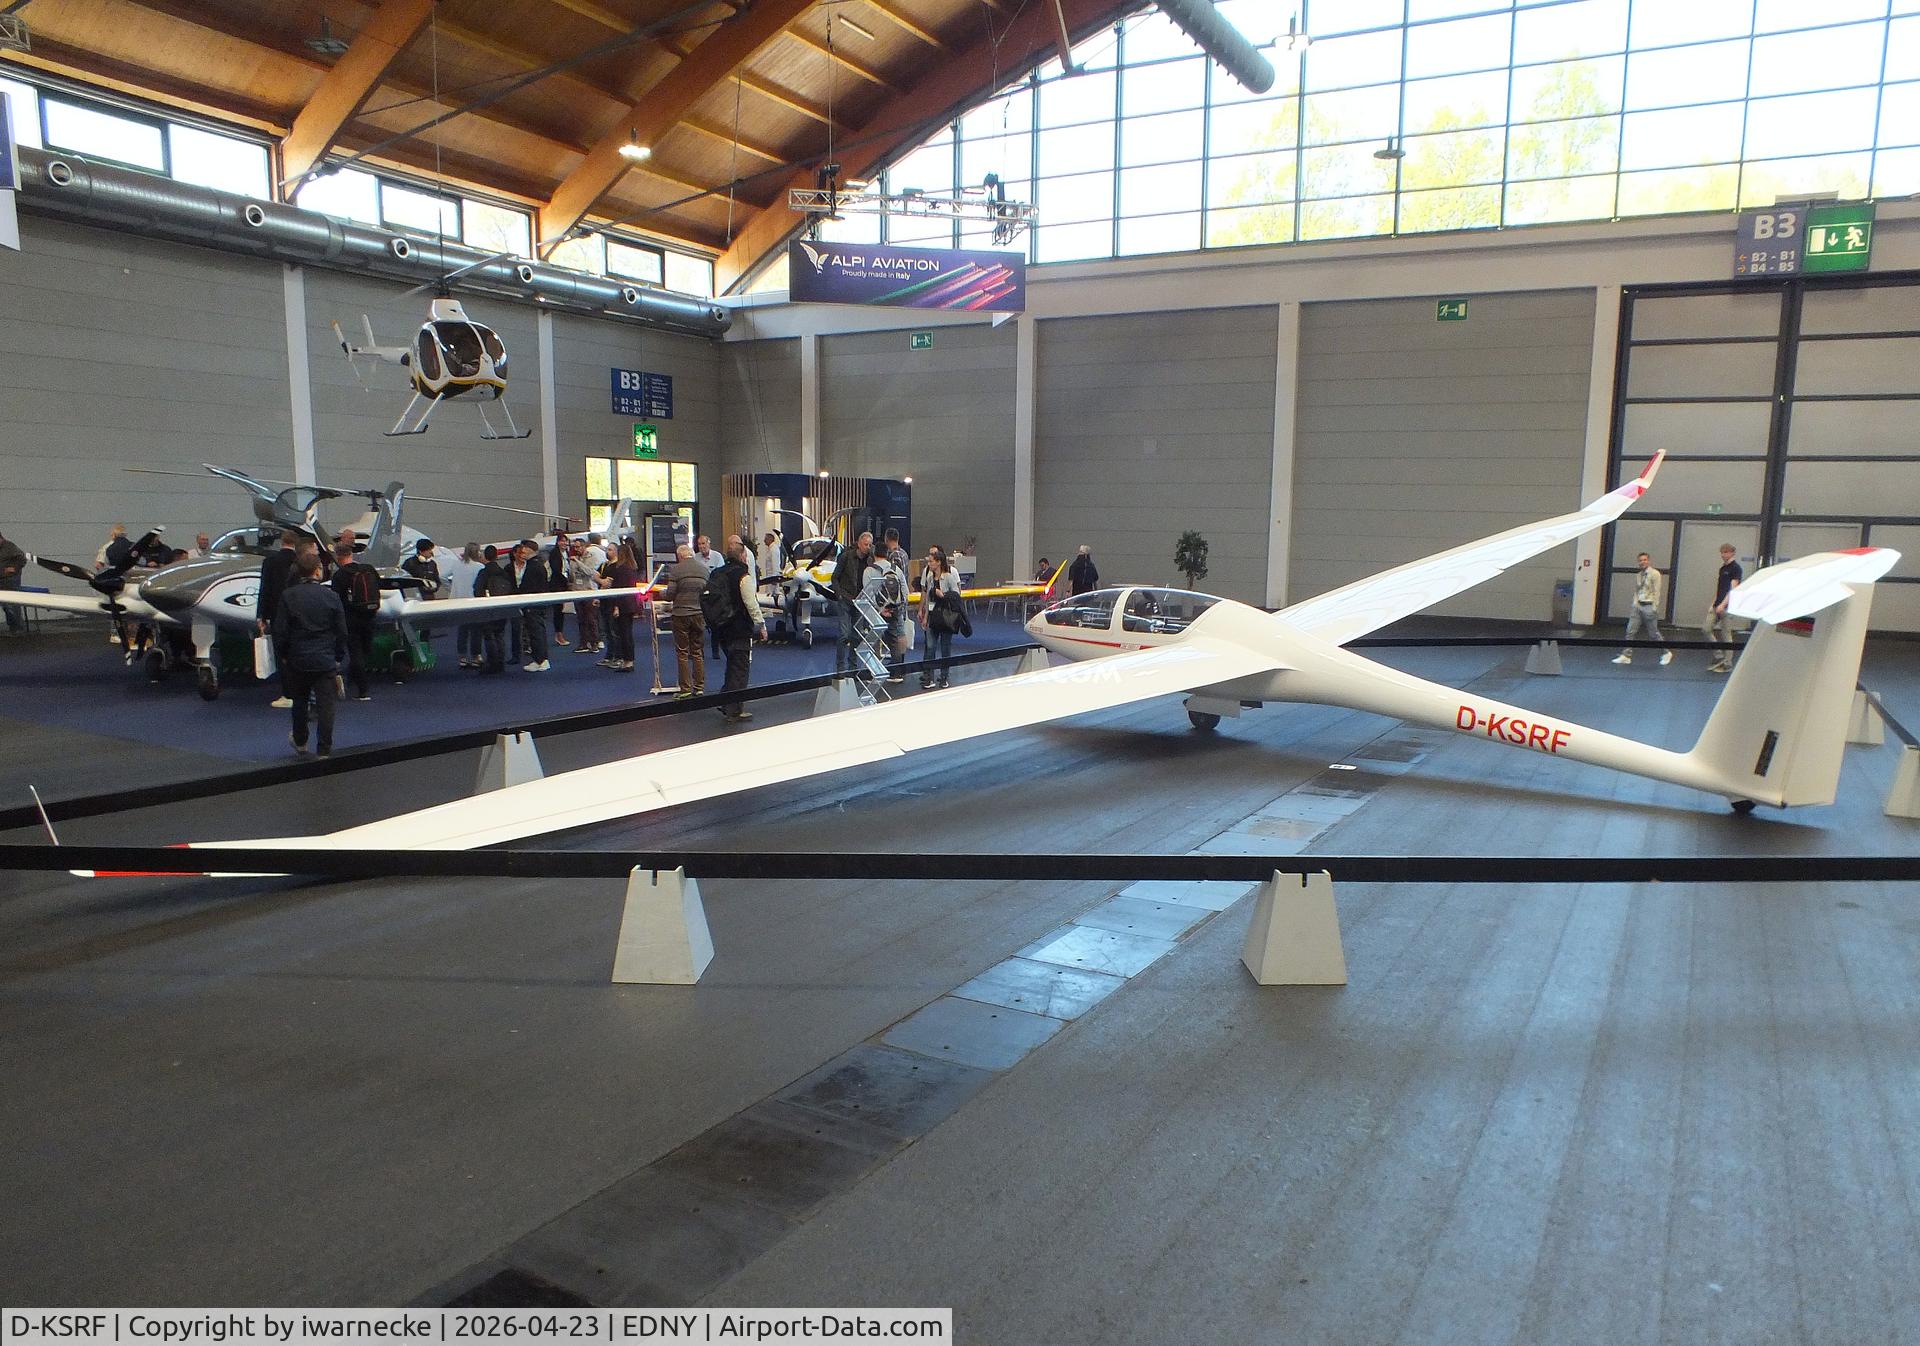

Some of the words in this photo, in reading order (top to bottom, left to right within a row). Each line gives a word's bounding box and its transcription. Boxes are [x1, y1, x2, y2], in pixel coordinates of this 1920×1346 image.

[1755, 213, 1796, 240] B3
[831, 255, 865, 267] ALPI
[872, 257, 940, 271] AVIATION
[1751, 252, 1767, 262] B2
[1780, 250, 1795, 260] B1
[842, 269, 867, 279] Proudly
[895, 272, 910, 280] Italy
[1751, 263, 1767, 273] B4
[1779, 261, 1794, 271] B5
[620, 371, 640, 390] B3
[1456, 705, 1571, 753] D-KSRF
